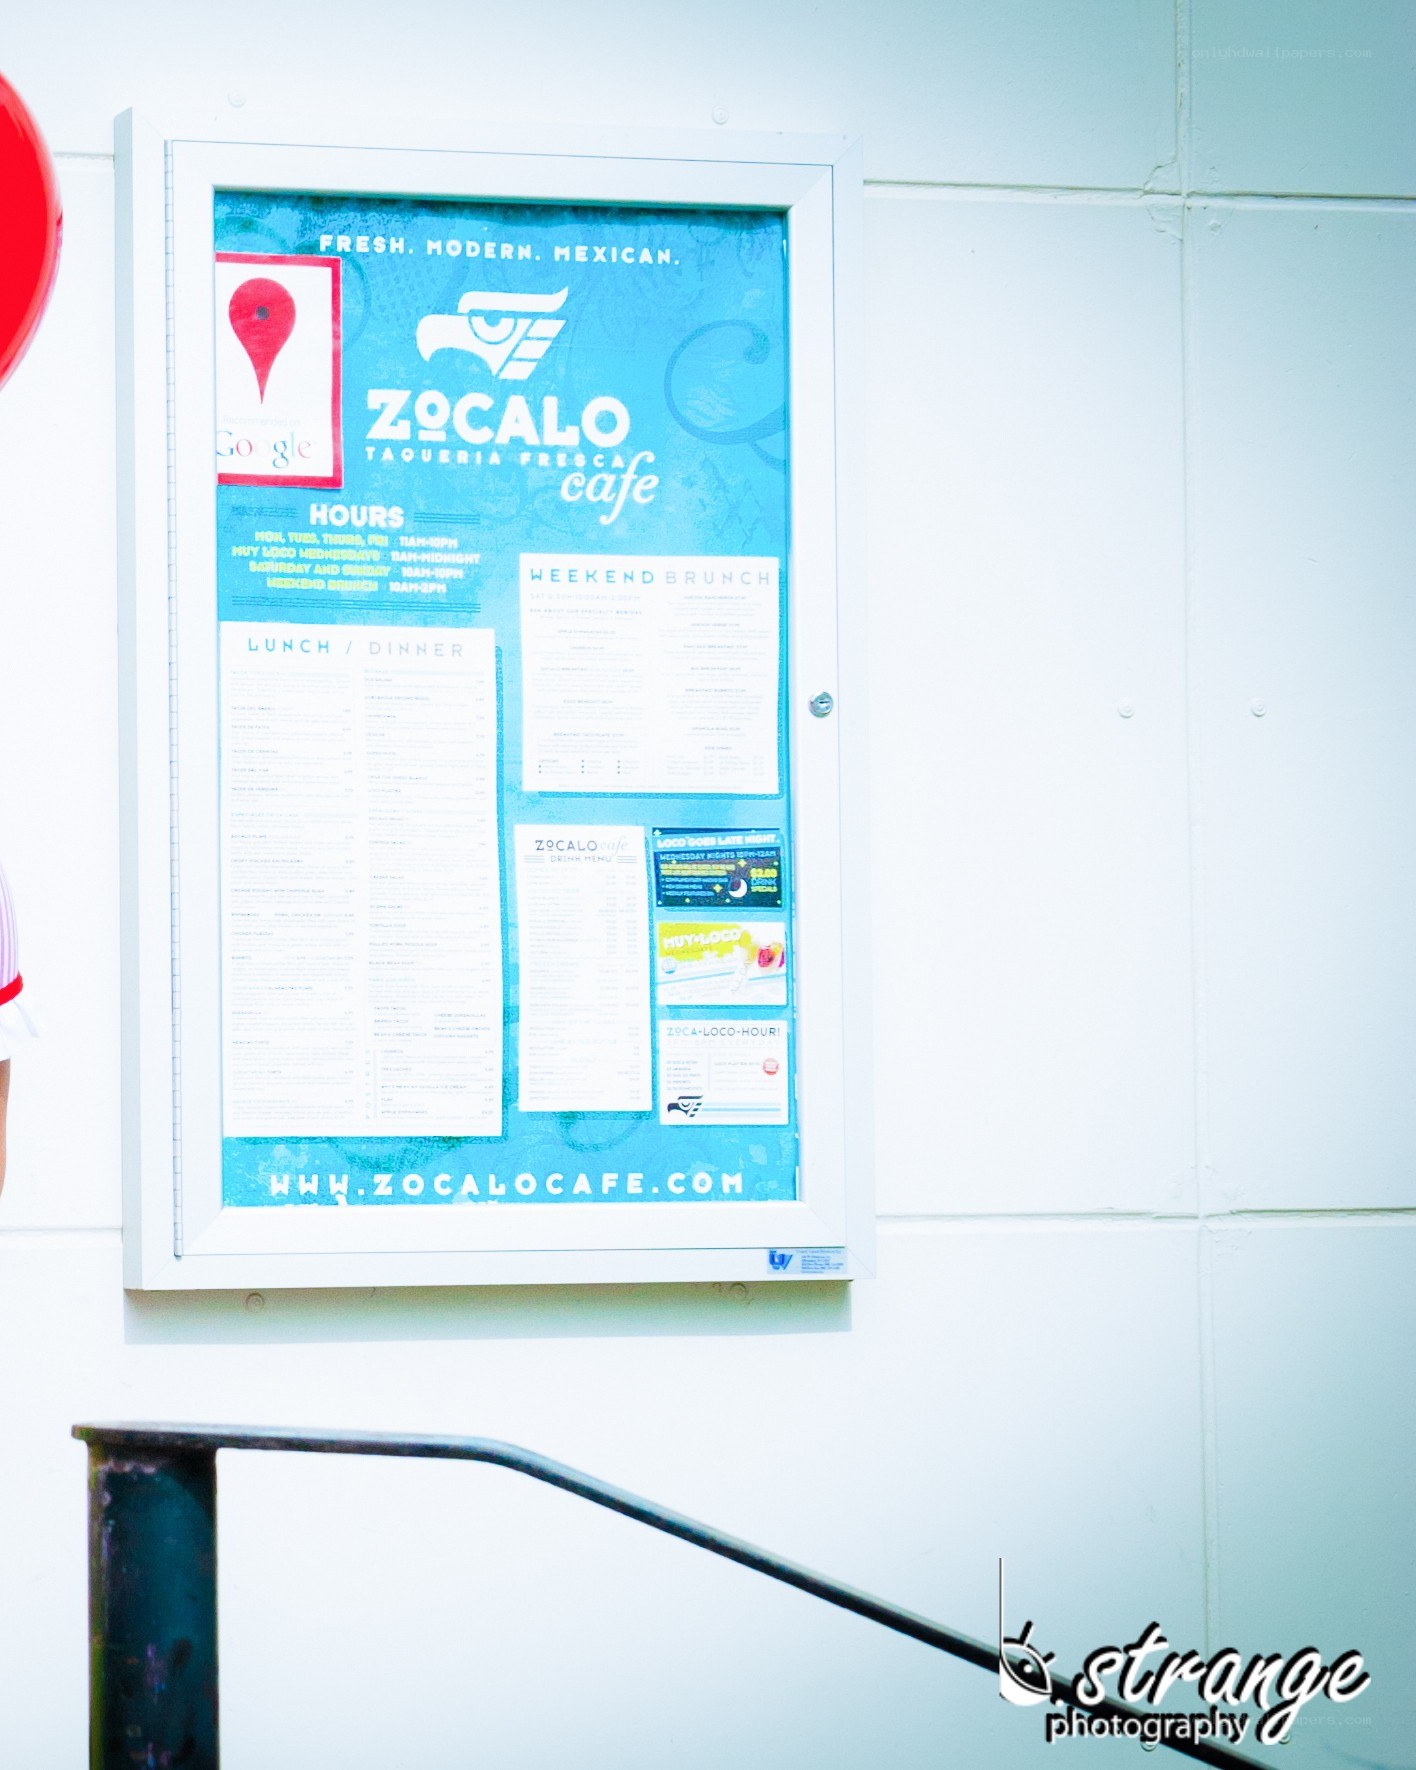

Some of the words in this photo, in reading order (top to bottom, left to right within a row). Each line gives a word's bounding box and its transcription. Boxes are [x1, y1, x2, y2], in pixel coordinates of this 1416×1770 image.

[319, 234, 414, 255] FRESH.
[426, 239, 541, 261] MODERN.
[554, 245, 680, 265] MEXICAN.
[365, 446, 501, 465] TAQUERIA
[520, 452, 625, 468] FRESCA
[560, 450, 659, 525] cafe
[309, 503, 404, 528] HOURS
[529, 568, 654, 584] WEEKEND
[665, 570, 770, 585] BRUNCH
[247, 637, 330, 654] LUNCH
[368, 641, 465, 657] DINNER
[600, 835, 629, 857] cafe
[717, 835, 744, 846] LATE
[550, 855, 582, 863] DRINK
[584, 855, 612, 863] MENU
[660, 853, 706, 861] WEDNESDAY
[270, 1172, 743, 1196] WWW.ZOCALOCAFE.COM
